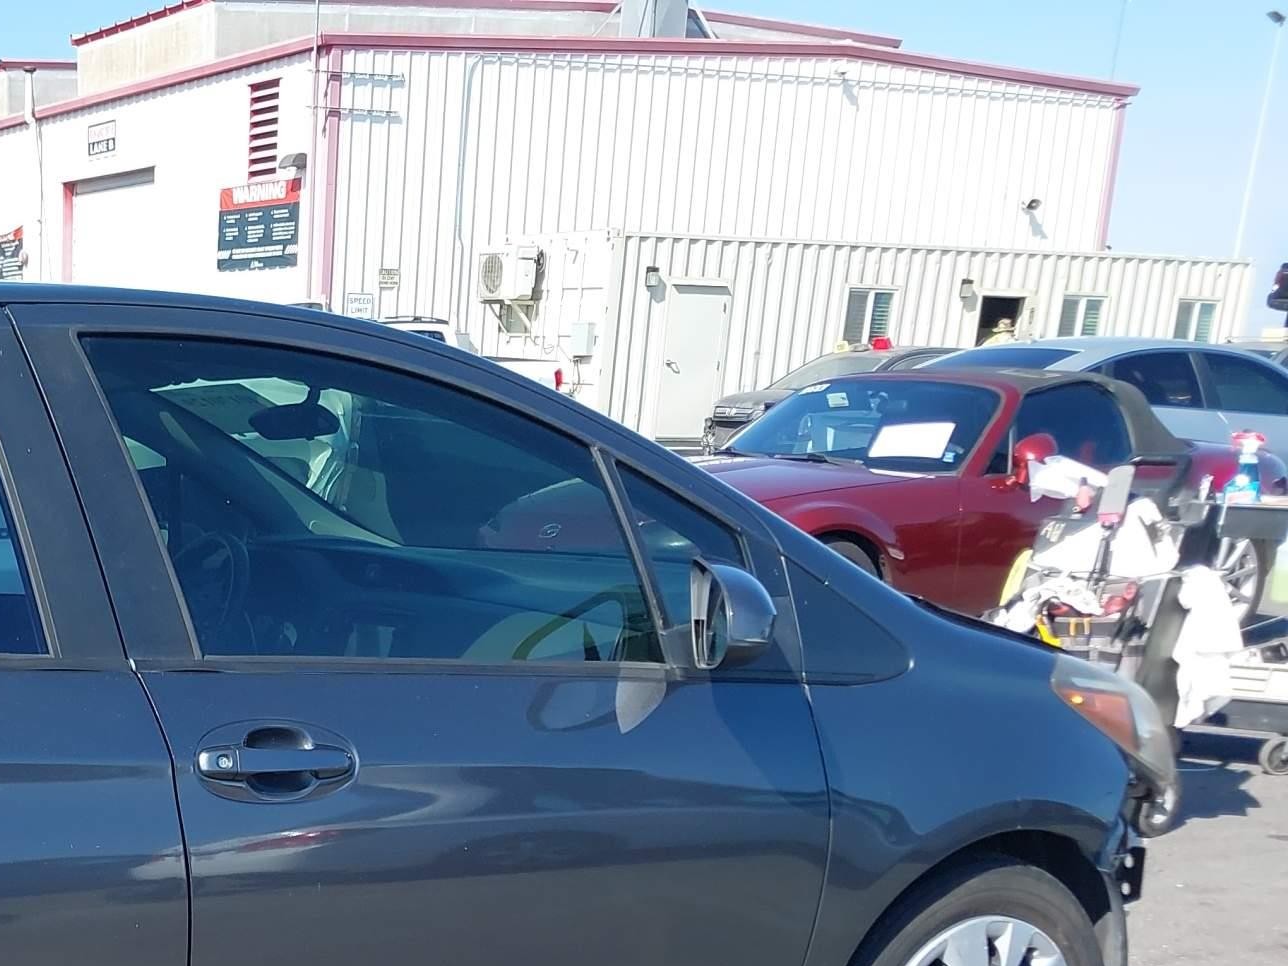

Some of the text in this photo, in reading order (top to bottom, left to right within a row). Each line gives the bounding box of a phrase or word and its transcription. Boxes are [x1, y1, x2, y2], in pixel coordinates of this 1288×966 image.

[90, 139, 108, 155] LANE
[232, 180, 287, 204] WARNING
[349, 297, 372, 305] SPEED
[350, 306, 369, 314] LIMIT
